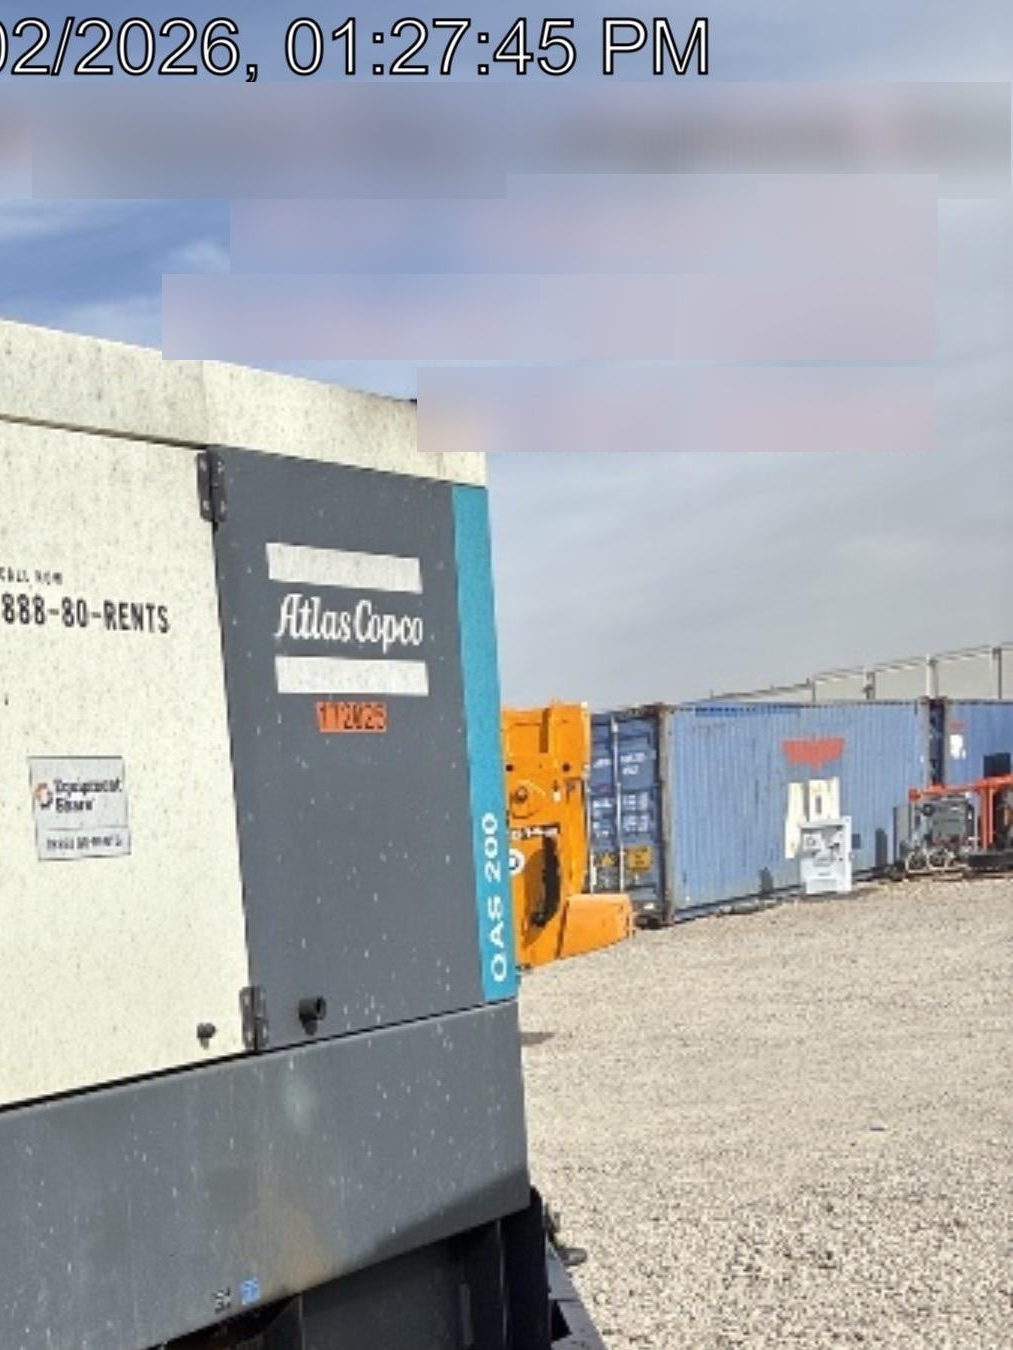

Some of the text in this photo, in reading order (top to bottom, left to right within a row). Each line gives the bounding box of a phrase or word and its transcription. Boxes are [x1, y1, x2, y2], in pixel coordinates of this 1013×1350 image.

[1, 592, 170, 633] 888-80-RENTS
[273, 593, 423, 654] Atlas Copco
[482, 813, 501, 882] 200
